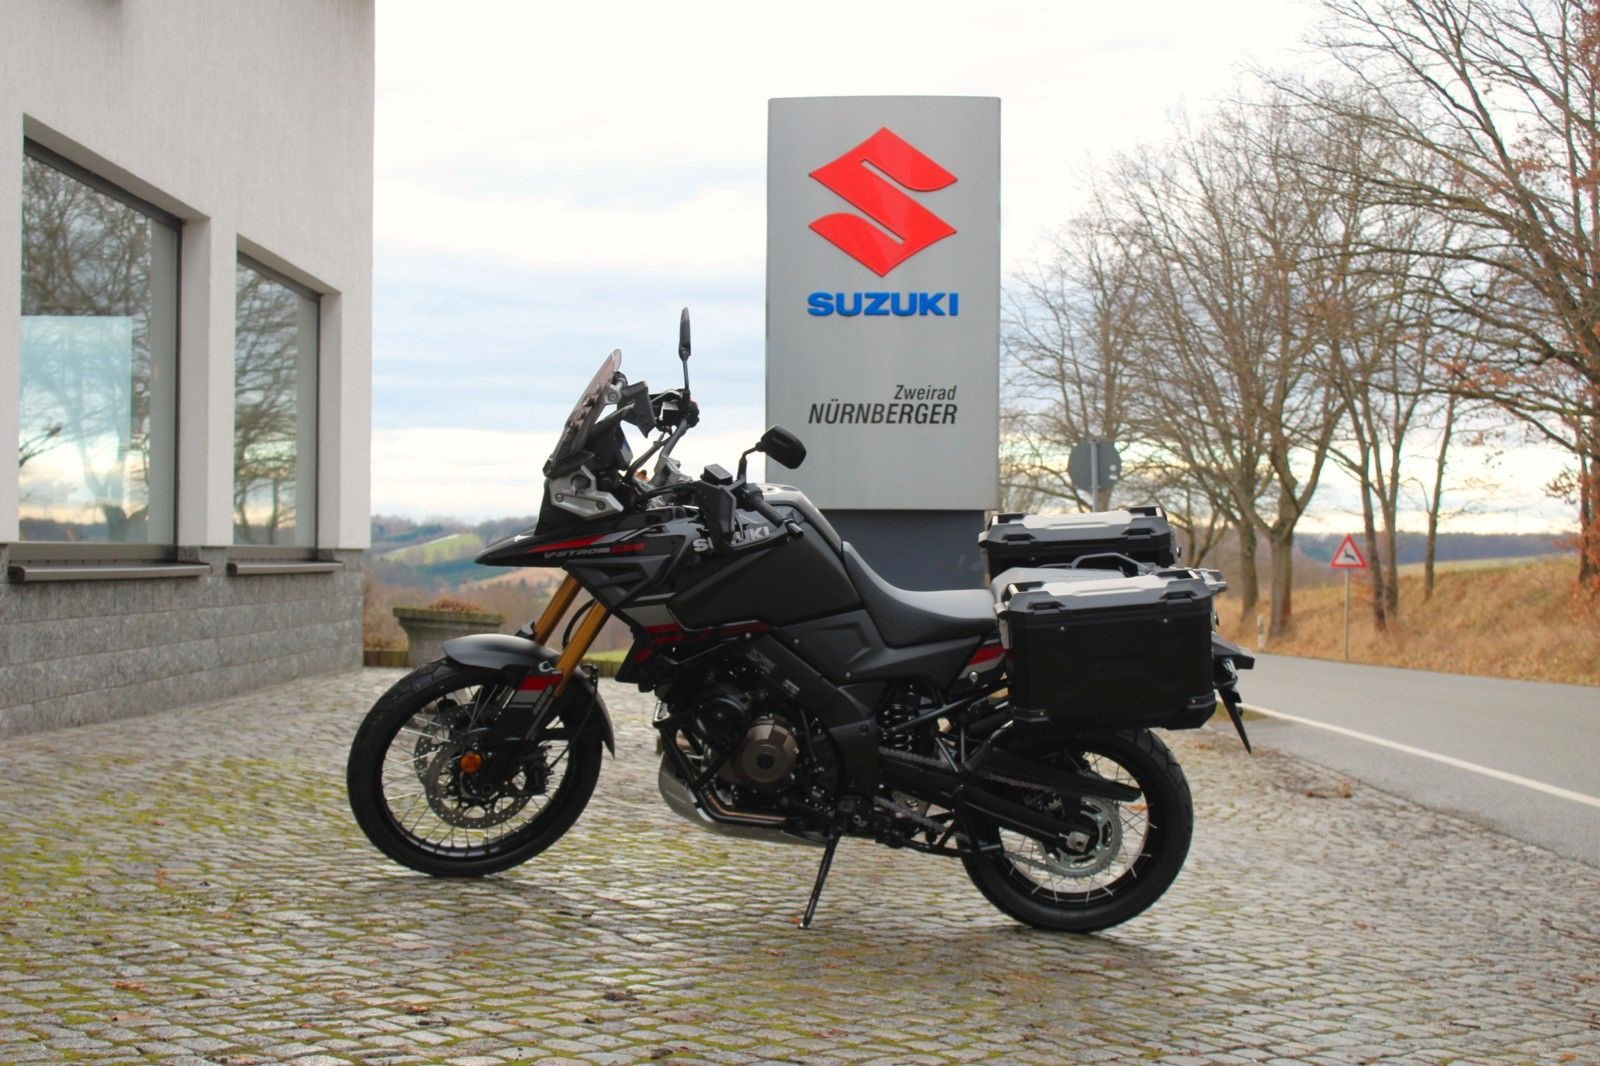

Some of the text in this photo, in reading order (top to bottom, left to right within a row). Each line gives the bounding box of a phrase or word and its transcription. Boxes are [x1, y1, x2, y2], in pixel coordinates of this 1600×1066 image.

[807, 292, 958, 317] SUZUKI
[894, 384, 958, 401] Zweirad
[808, 398, 958, 425] NÜRNBERGER
